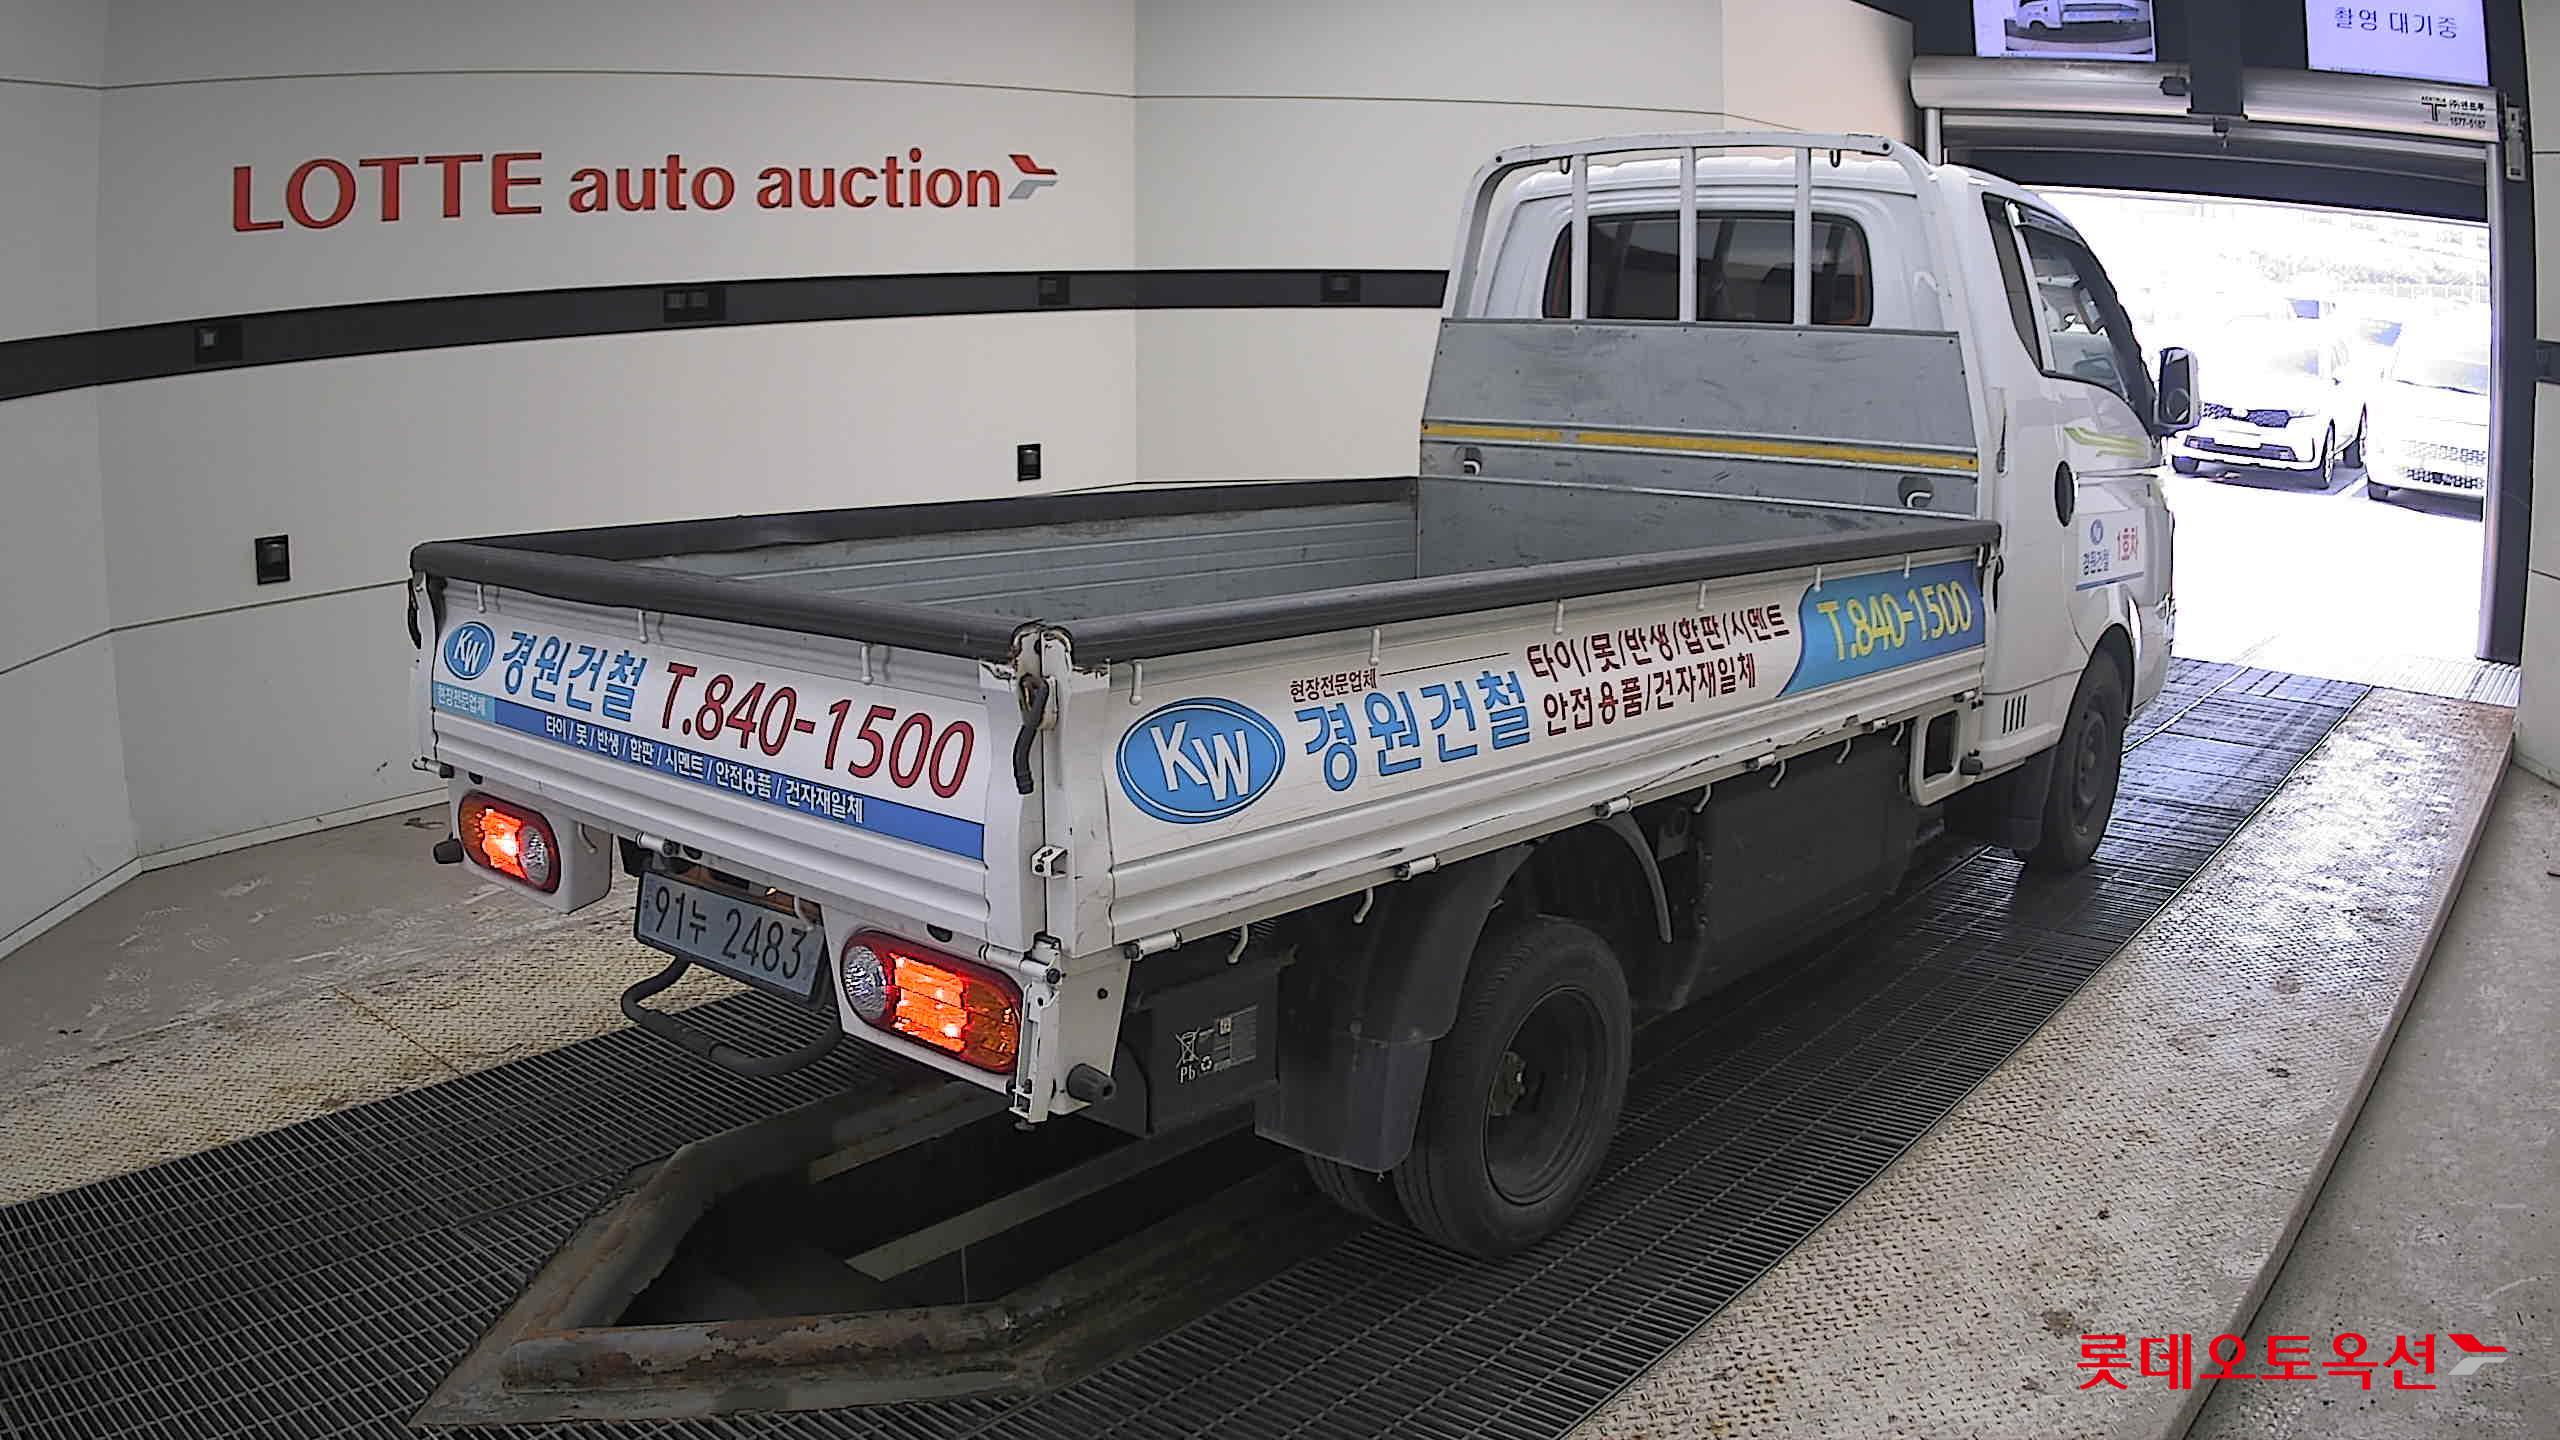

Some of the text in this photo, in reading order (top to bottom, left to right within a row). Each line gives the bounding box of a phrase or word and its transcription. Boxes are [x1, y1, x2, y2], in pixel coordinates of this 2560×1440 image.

[2336, 7, 2377, 31] 촬영
[233, 148, 1001, 233] LOTTE auto auction
[453, 630, 485, 675] KW
[1817, 580, 1974, 661] T.840-1500
[502, 631, 975, 798] 경원건철 T.840-1500
[1289, 669, 1378, 702] 현장전문업체
[545, 714, 567, 735] 타이
[575, 722, 589, 746] 못
[597, 729, 619, 756] 반생
[629, 739, 654, 767] 합판
[665, 747, 705, 779] 시멘트
[715, 764, 772, 799] 안전용품
[785, 780, 865, 824] 건자재일체
[1149, 720, 1250, 801] KW
[1295, 670, 1531, 792] 경원건철
[655, 886, 808, 979] 91누 2483
[1180, 1065, 1197, 1084] Pb
